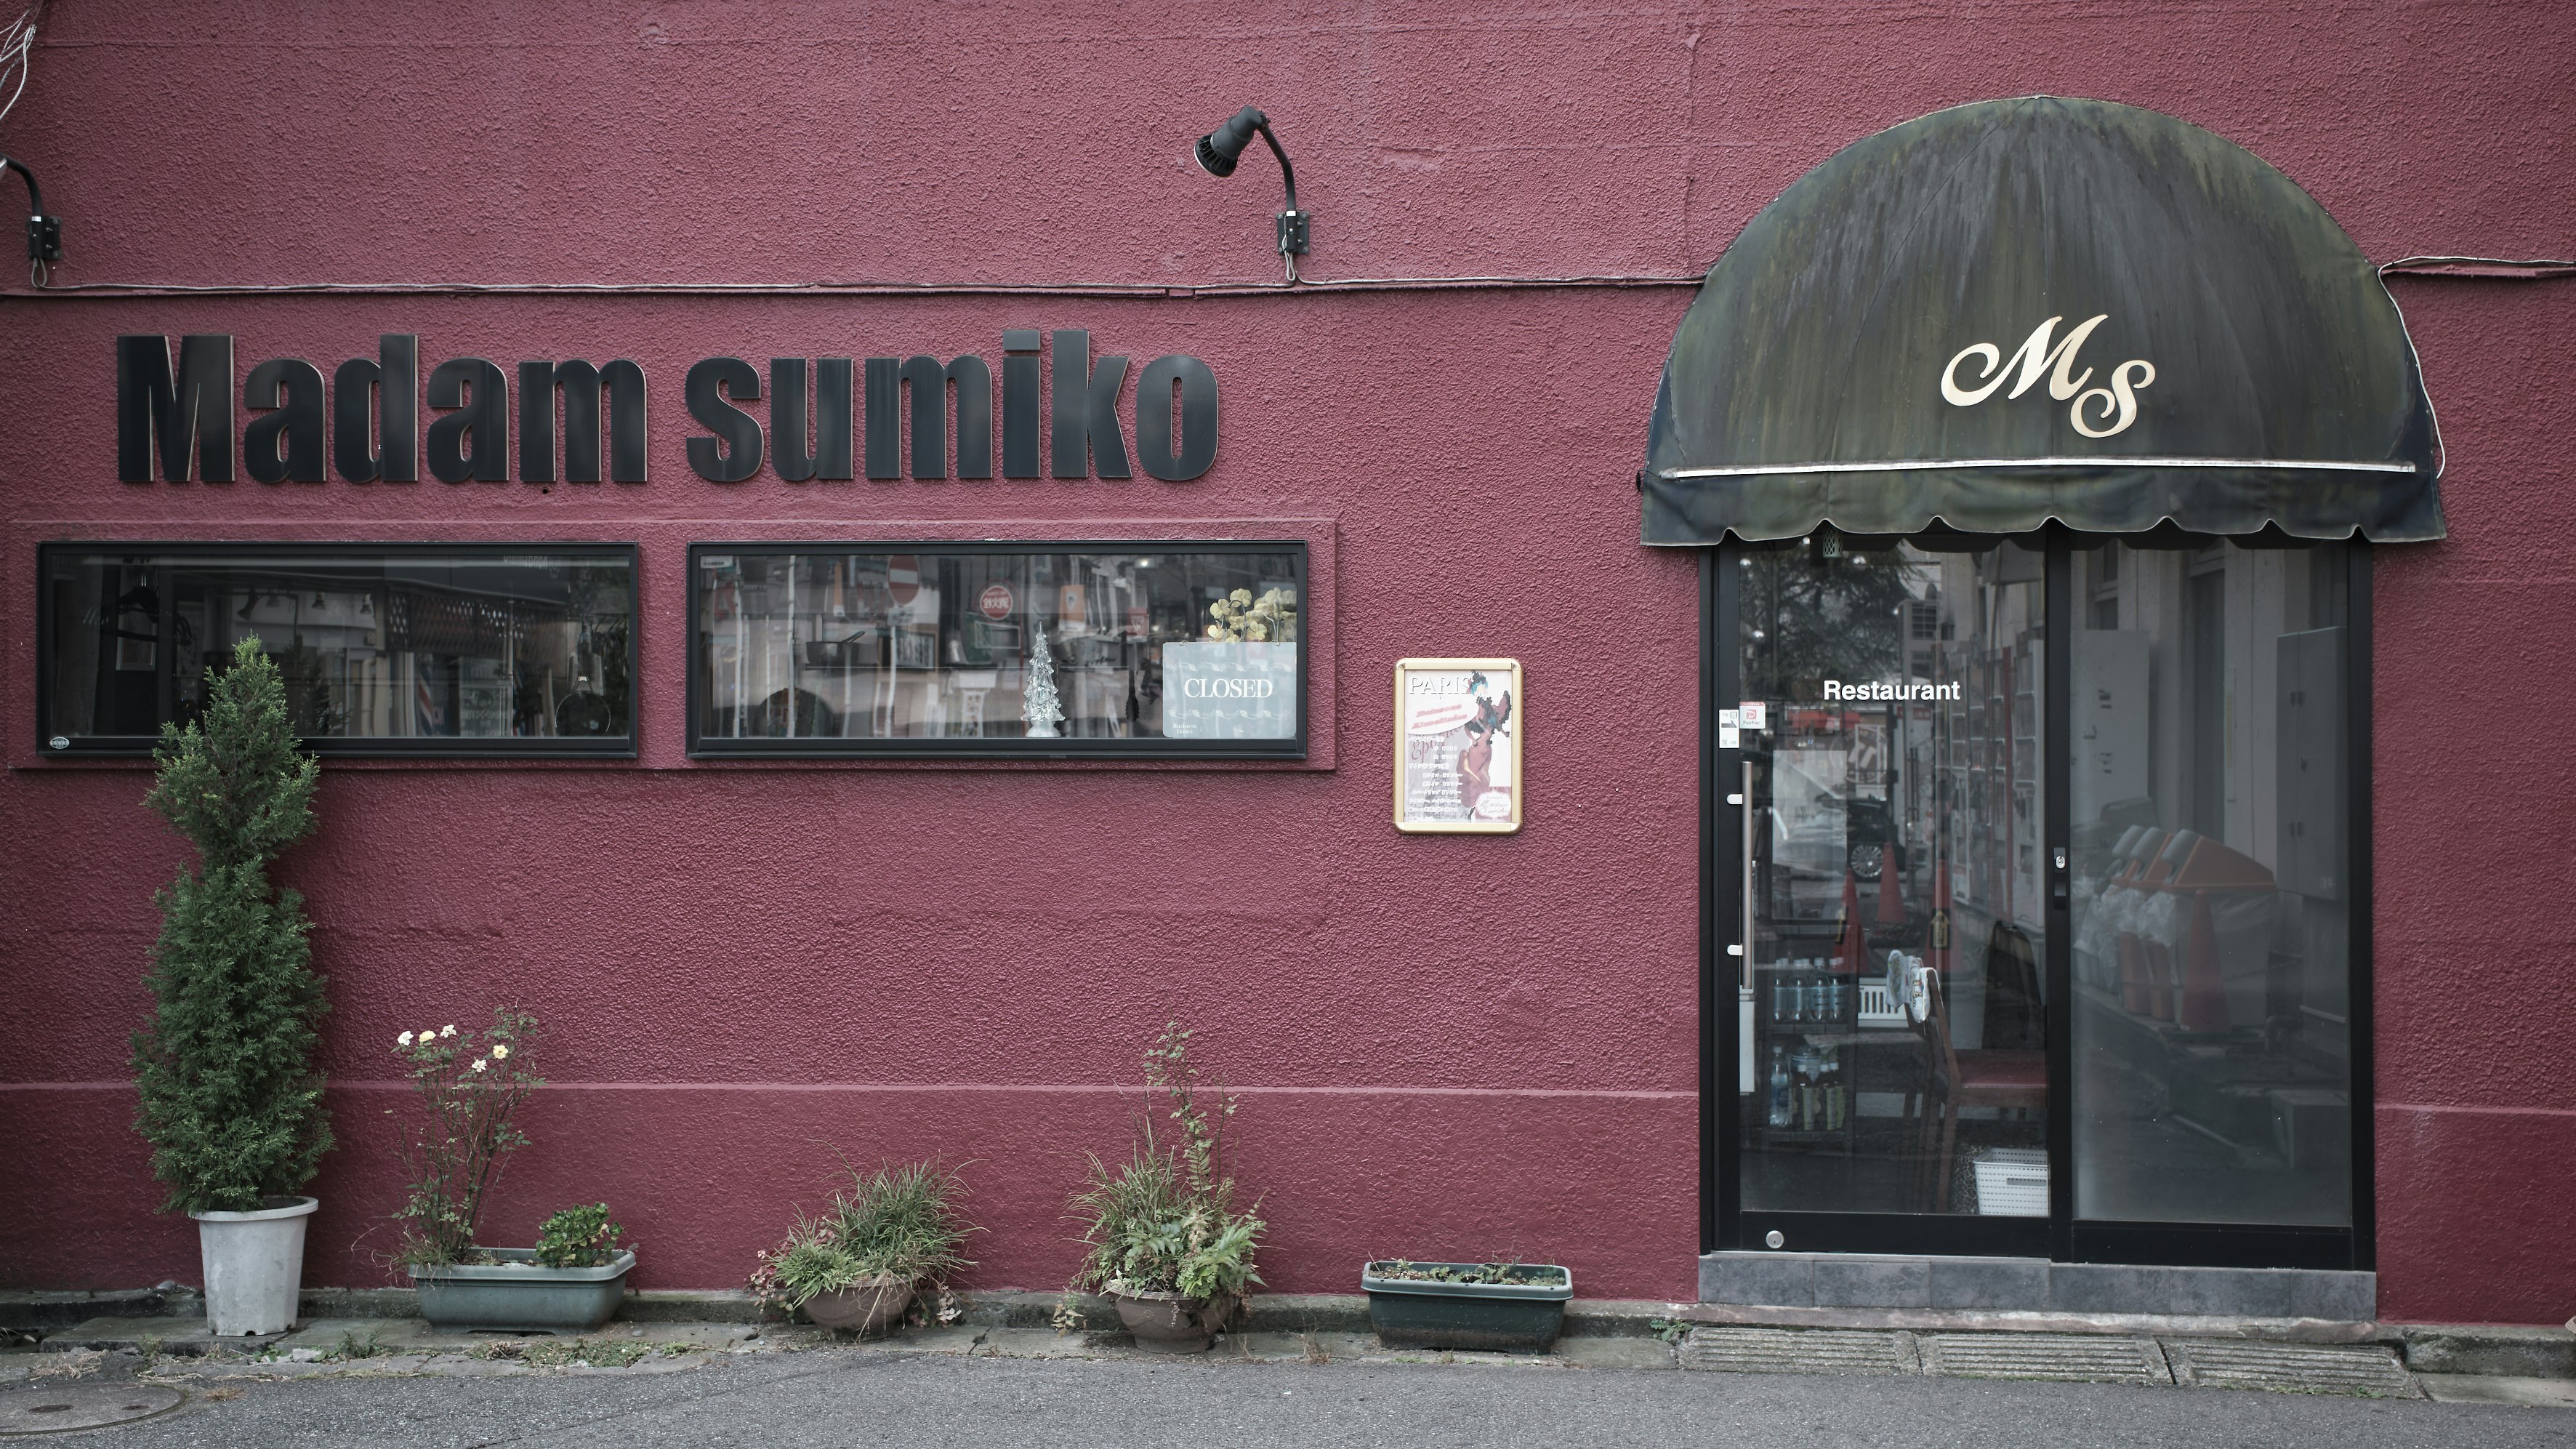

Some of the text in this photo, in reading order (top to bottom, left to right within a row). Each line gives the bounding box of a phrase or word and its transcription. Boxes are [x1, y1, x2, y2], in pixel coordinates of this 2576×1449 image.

[117, 329, 1219, 483] Madam sumiko
[1184, 678, 1273, 698] CLOSED
[1824, 680, 1960, 700] Restaurant
